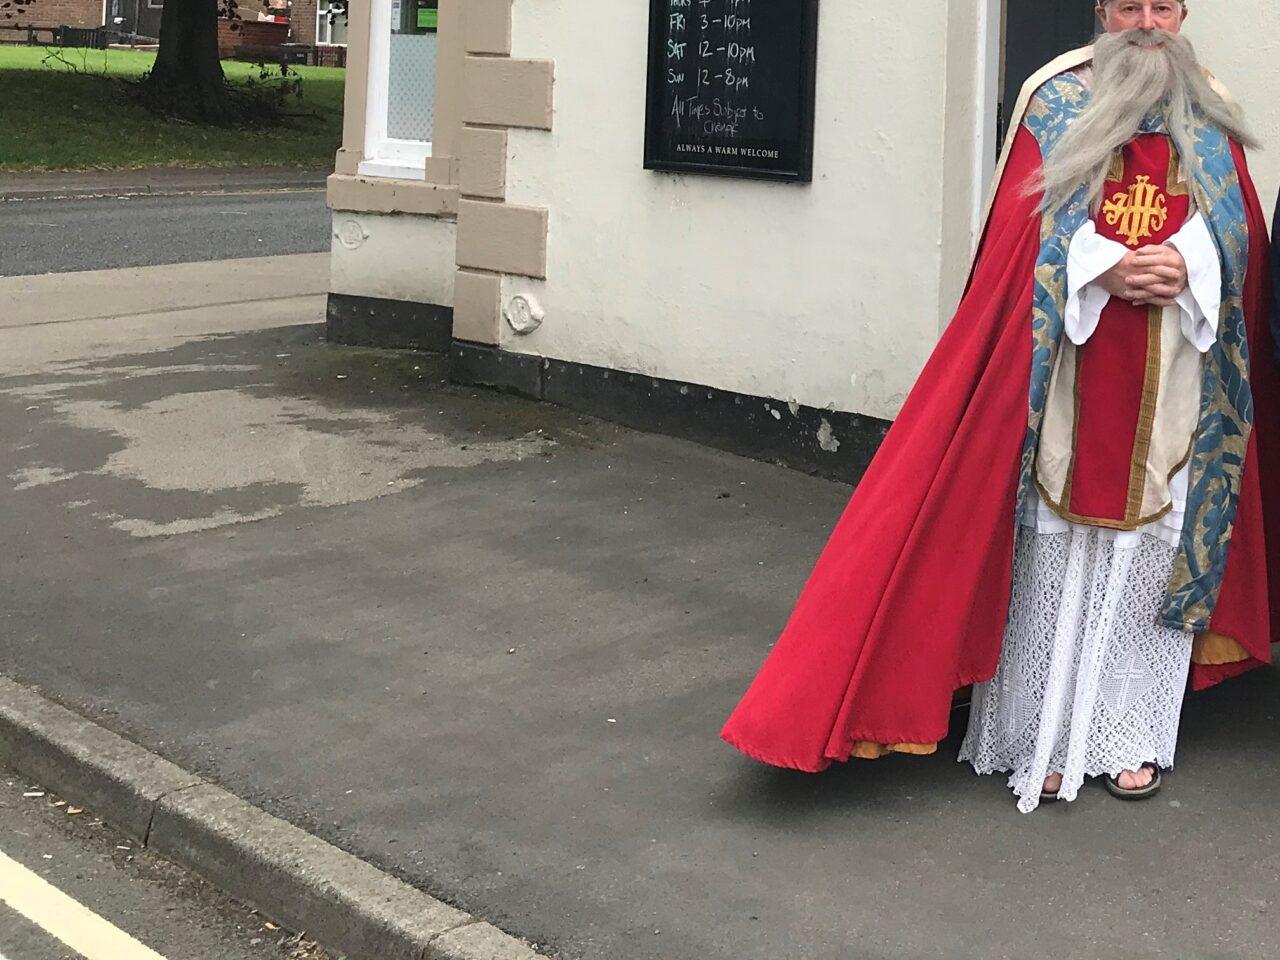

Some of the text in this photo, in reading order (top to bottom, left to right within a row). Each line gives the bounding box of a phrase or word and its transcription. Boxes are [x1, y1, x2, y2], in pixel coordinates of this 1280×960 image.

[669, 12, 686, 30] FRI
[667, 39, 688, 60] SAT
[676, 143, 780, 159] ALWAYS A WARM WELCOME
